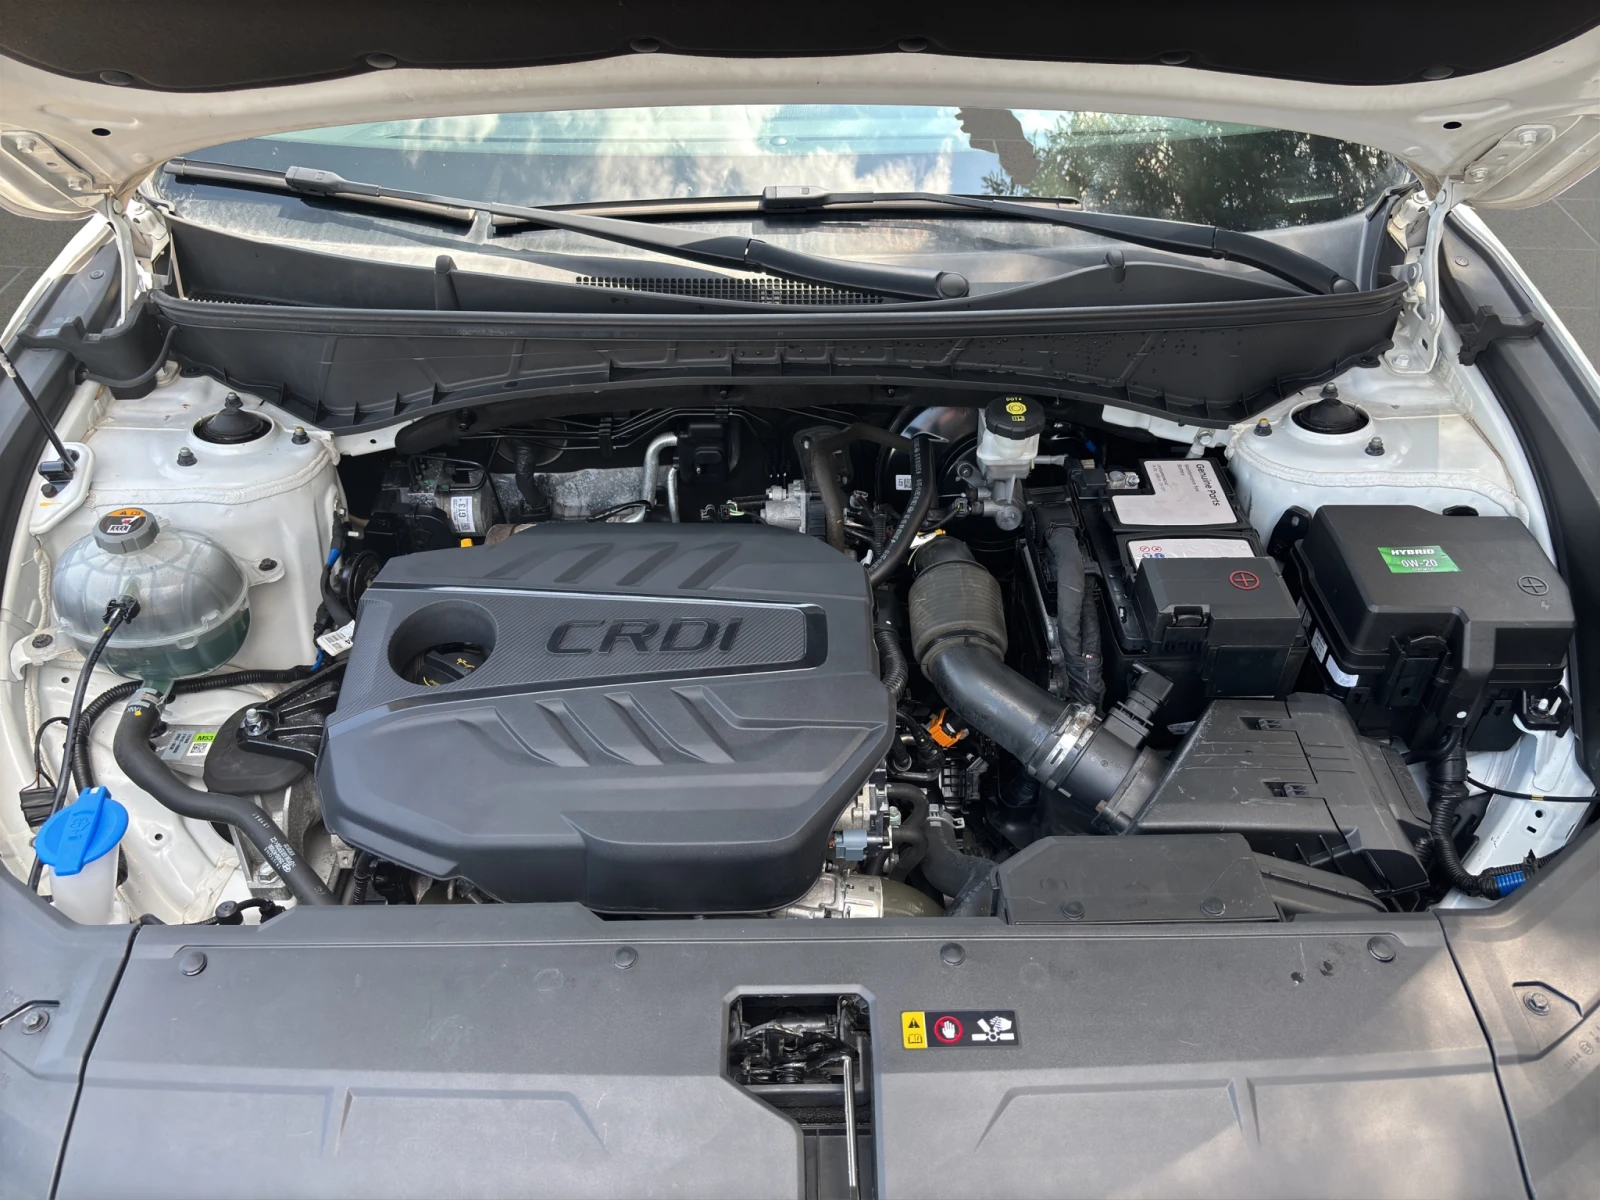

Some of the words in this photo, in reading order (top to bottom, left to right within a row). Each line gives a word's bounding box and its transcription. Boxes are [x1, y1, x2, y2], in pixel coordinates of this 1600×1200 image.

[1196, 463, 1212, 489] Genuine
[1207, 488, 1220, 506] Parts
[458, 503, 467, 518] GT3
[1390, 548, 1435, 556] HYBRID
[1400, 558, 1438, 568] 0W-20
[545, 616, 744, 655] CRDI
